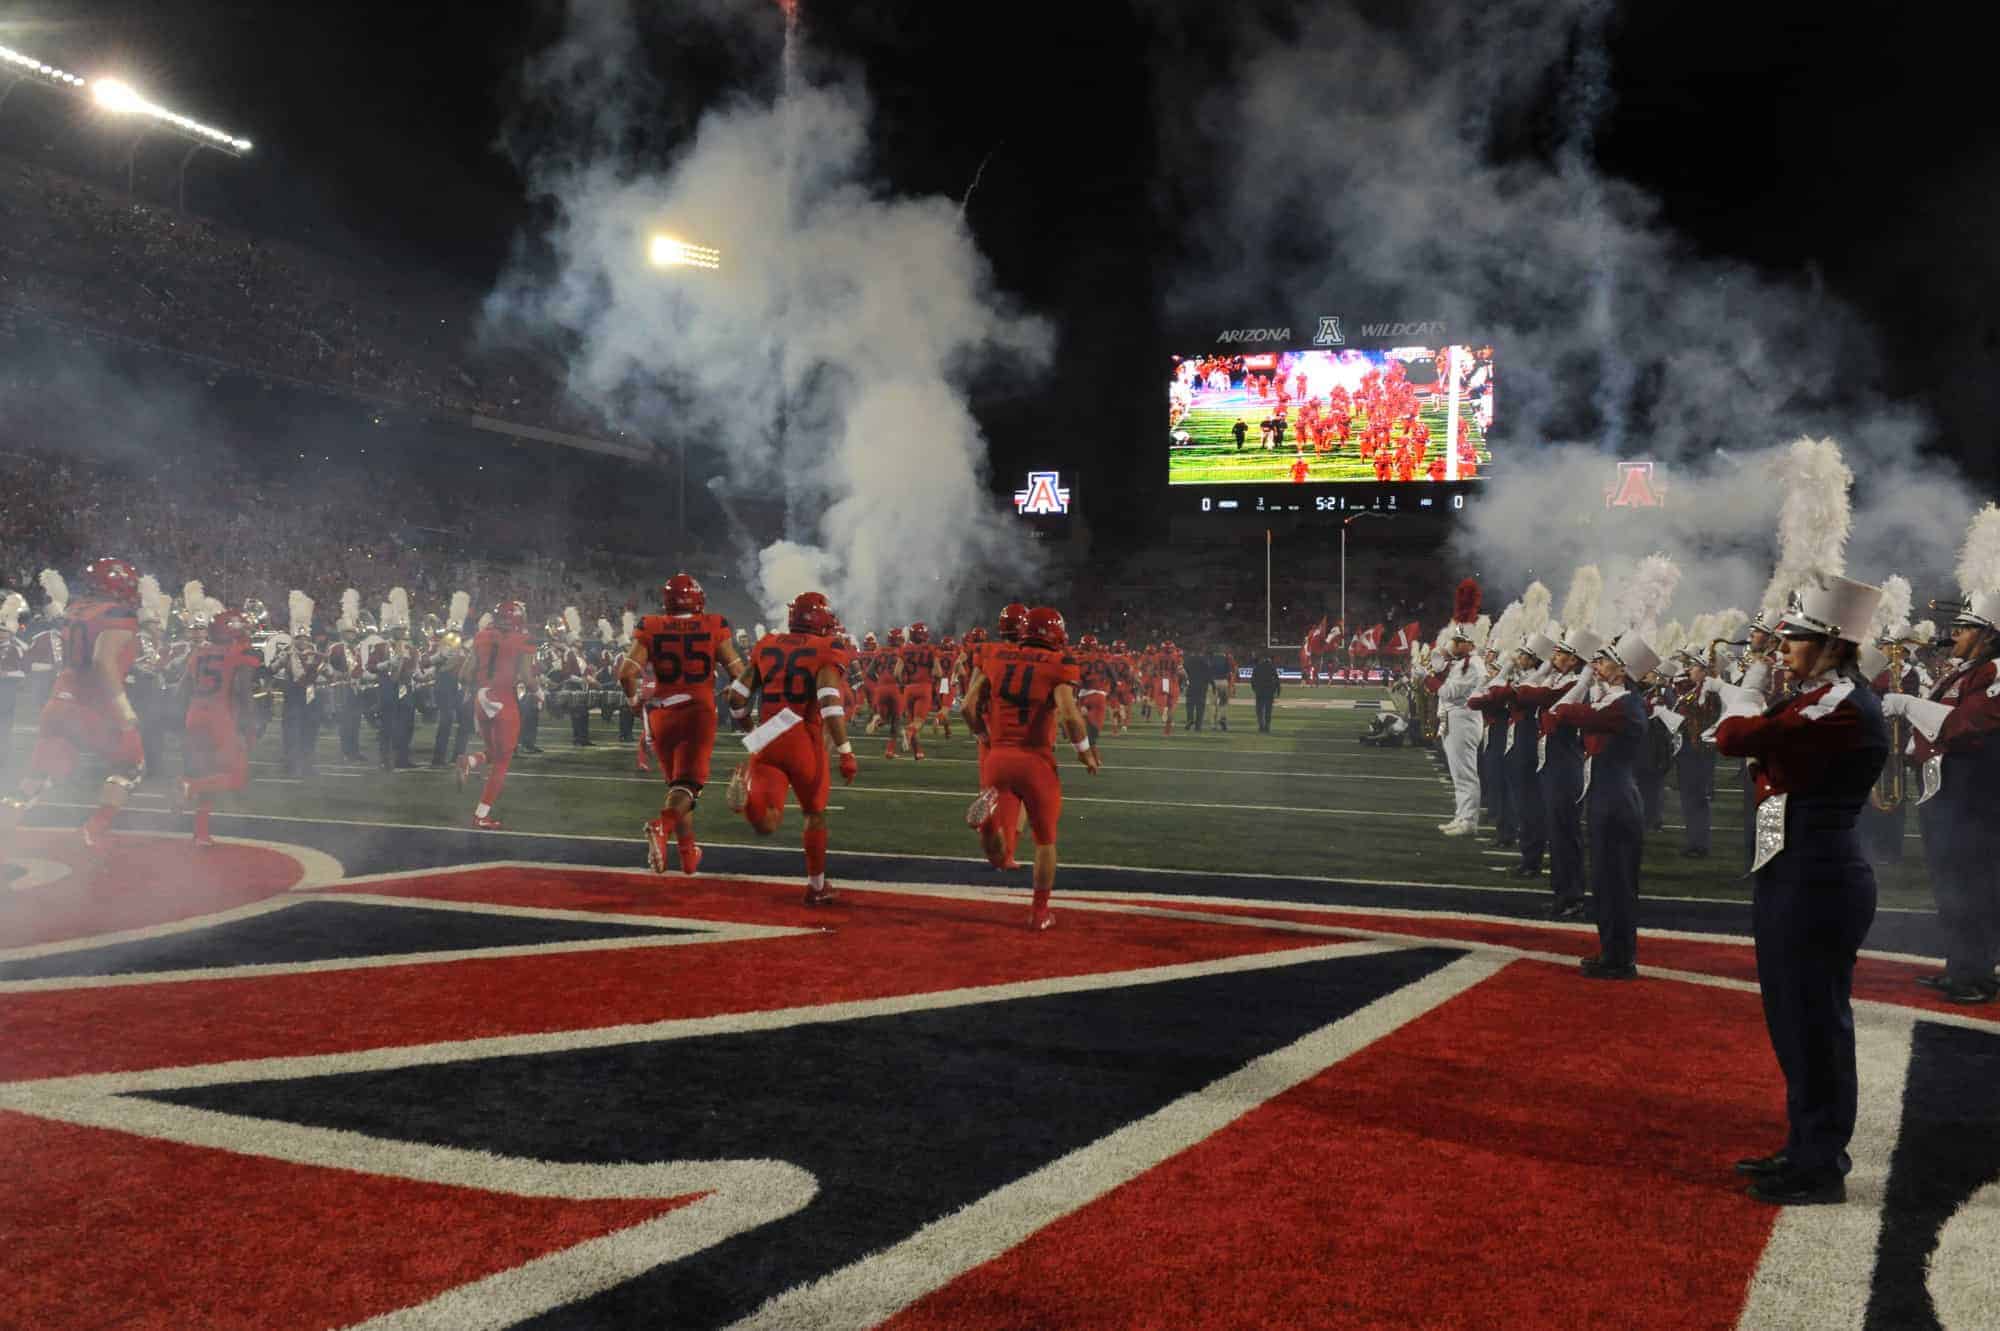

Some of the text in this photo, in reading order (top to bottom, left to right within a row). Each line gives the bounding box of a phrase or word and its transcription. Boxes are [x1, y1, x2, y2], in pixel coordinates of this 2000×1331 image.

[1216, 328, 1291, 343] ARIZONA
[1313, 316, 1345, 346] A
[1014, 471, 1070, 514] A
[1202, 498, 1211, 511] 0
[1316, 496, 1345, 510] 5:21
[1453, 495, 1463, 509] 0
[653, 633, 711, 683] 55
[760, 647, 817, 704] 26
[1000, 663, 1034, 725] 4
